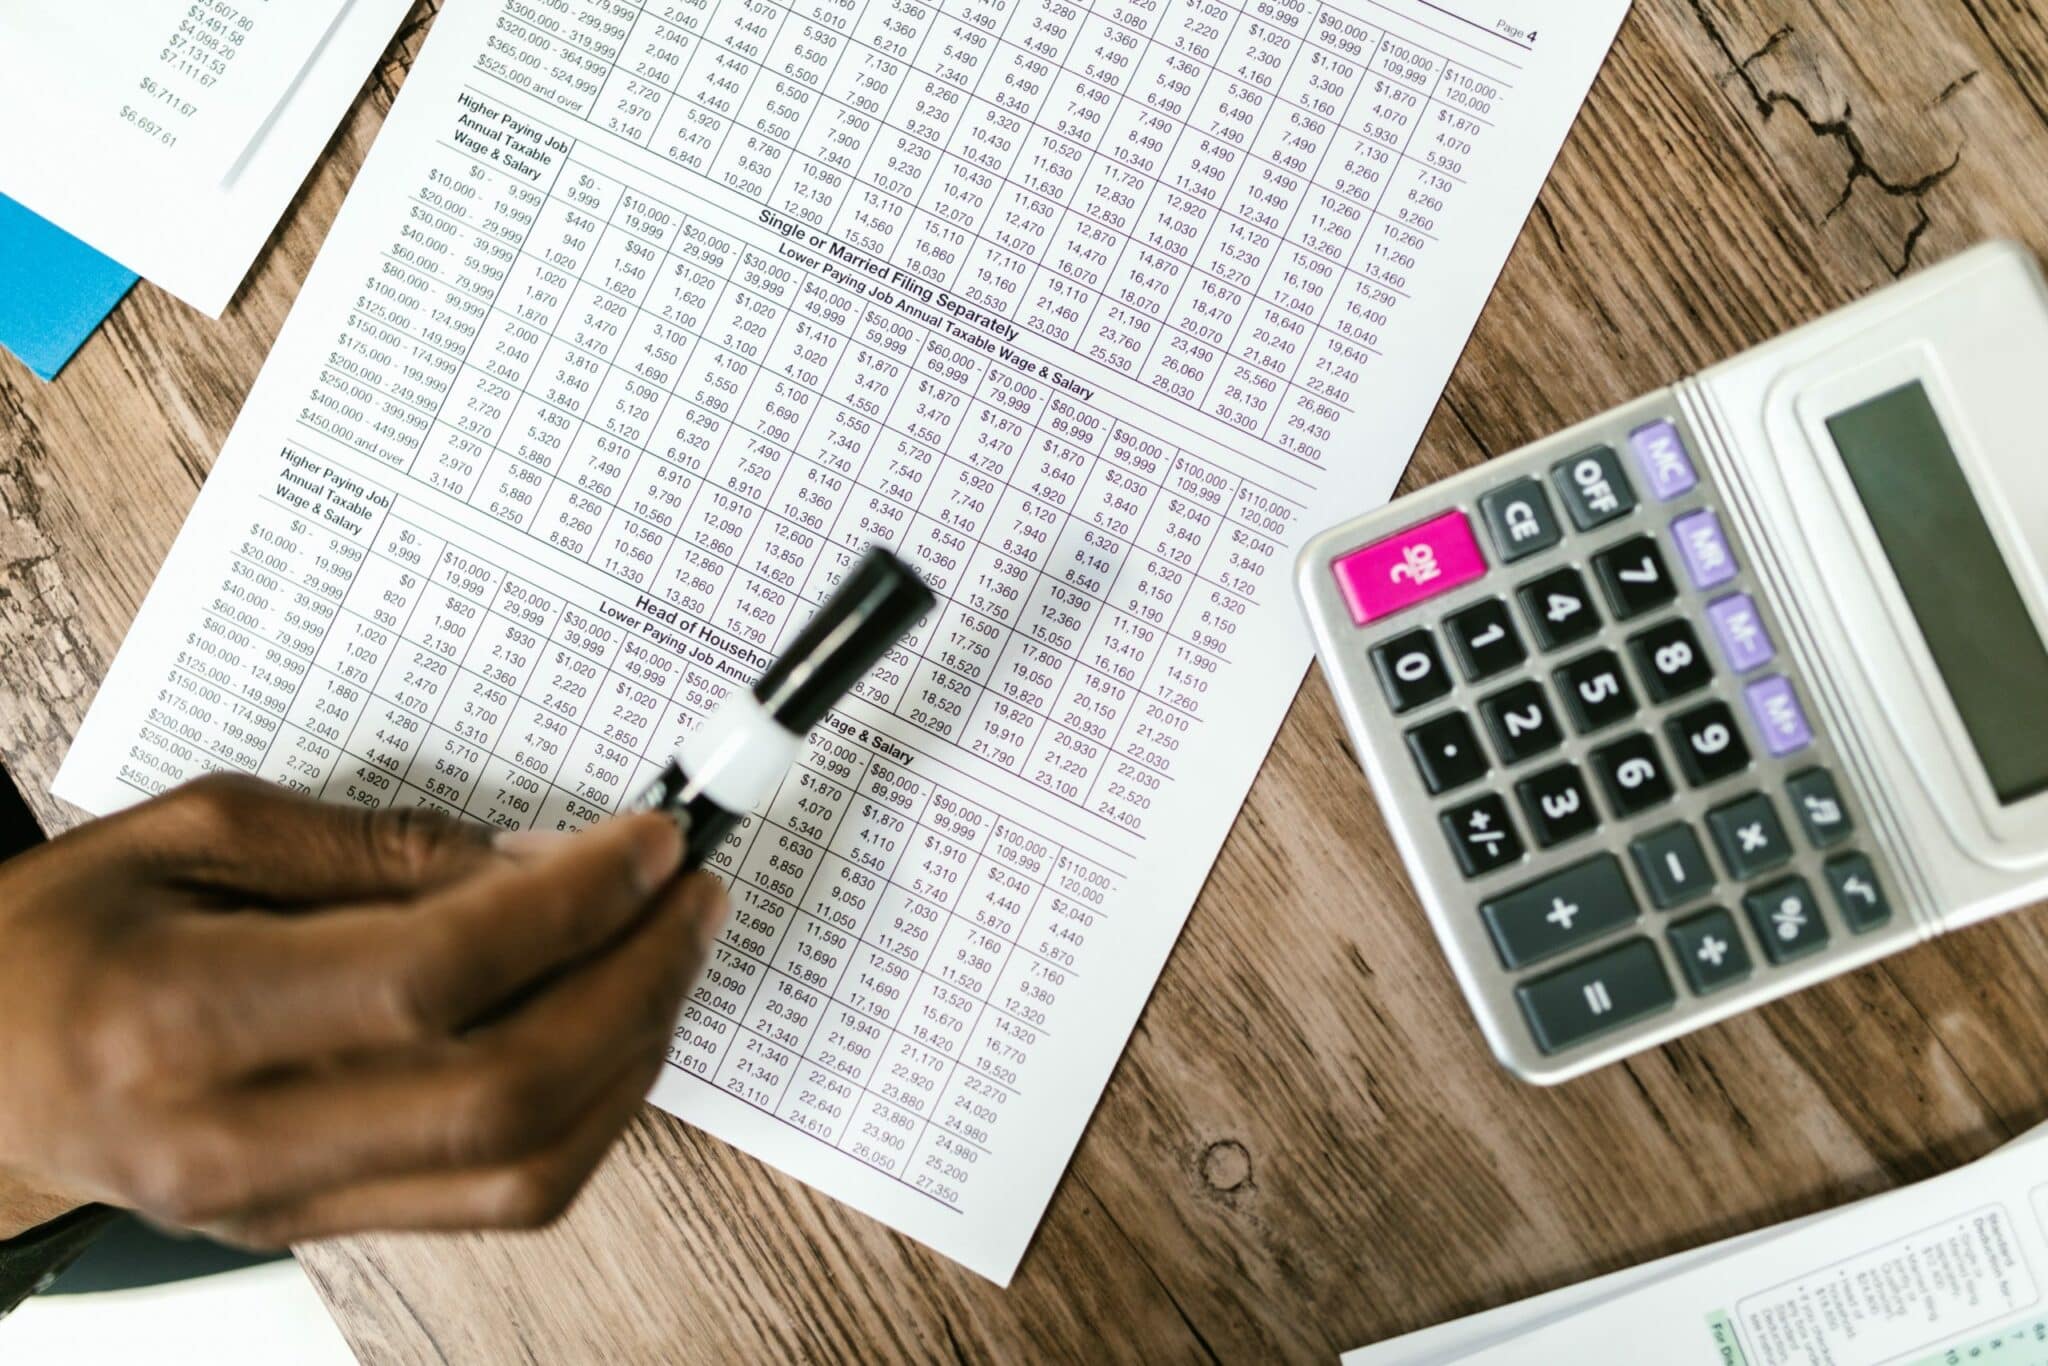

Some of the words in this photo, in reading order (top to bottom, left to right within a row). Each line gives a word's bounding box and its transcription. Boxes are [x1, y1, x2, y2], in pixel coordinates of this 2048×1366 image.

[882, 17, 917, 40] 4,360
[961, 7, 997, 30] 3,490
[1257, 4, 1300, 28] 89,999
[1319, 30, 1362, 57] 99,999
[1495, 18, 1525, 39] Page
[1526, 29, 1539, 44] 4
[1094, 46, 1129, 69] 4,490
[1174, 35, 1211, 60] 3,160
[1245, 45, 1282, 69] 2,300
[935, 62, 969, 86] 7,340
[1311, 51, 1354, 79] $1,100
[476, 53, 533, 88] $525,000
[531, 83, 557, 100] and
[556, 95, 584, 112] over
[626, 80, 662, 104] 2,720
[1446, 87, 1491, 115] 120,000
[456, 91, 501, 121] Higher
[500, 113, 544, 145] Paying
[543, 135, 569, 155] Job
[608, 116, 642, 141] 3,140
[1437, 108, 1481, 136] $1,870
[457, 113, 504, 142] Annual
[504, 133, 552, 166] Taxable
[1127, 129, 1164, 153] 8,490
[1281, 130, 1317, 154] 7,490
[453, 128, 489, 156] Wage
[489, 147, 501, 161] &
[502, 153, 543, 182] Salary
[1033, 154, 1073, 181] 11,630
[1426, 151, 1462, 174] 5,930
[802, 162, 842, 189] 10,980
[1176, 175, 1217, 201] 11,340
[567, 186, 601, 210] 9,999
[1407, 188, 1444, 212] 8,260
[564, 211, 596, 233] $440
[625, 214, 664, 240] 19,999
[472, 236, 514, 263] 39,999
[986, 248, 1027, 275] 17,110
[614, 257, 646, 281] 1,540
[758, 208, 806, 241] Single
[808, 235, 828, 249] or
[827, 241, 891, 280] Married
[890, 271, 934, 303] Filing
[935, 292, 1020, 343] Separately
[906, 257, 946, 284] 18,030
[526, 285, 558, 308] 1,870
[735, 292, 777, 320] $1,020
[1355, 280, 1397, 308] 15,290
[662, 304, 697, 328] 2,100
[777, 235, 822, 270] Lower
[821, 262, 867, 295] Paying
[867, 286, 894, 305] Job
[894, 298, 944, 329] Annual
[945, 319, 996, 354] Taxable
[998, 345, 1037, 373] Wage
[1037, 365, 1050, 380] &
[1051, 371, 1095, 402] Salary
[504, 321, 540, 345] 2,000
[1252, 327, 1296, 355] 20,240
[1170, 336, 1214, 364] 23,490
[390, 383, 439, 413] 249,999
[918, 379, 961, 408] $1,870
[989, 387, 1032, 415] 79,999
[764, 400, 800, 425] 6,690
[299, 407, 355, 441] $450,000
[353, 436, 379, 454] and
[378, 448, 405, 466] over
[1278, 433, 1322, 461] 31,800
[1648, 438, 1688, 483] MC
[279, 445, 323, 475] Higher
[322, 467, 365, 499] Paying
[365, 490, 390, 509] Job
[807, 467, 843, 492] 8,140
[1177, 476, 1222, 505] 109,999
[1573, 458, 1619, 513] OFF
[279, 467, 325, 496] Annual
[326, 487, 373, 521] Taxable
[275, 483, 311, 510] Wage
[311, 502, 322, 516] &
[323, 508, 363, 537] Salary
[489, 501, 524, 525] 6,250
[1504, 501, 1540, 542] CE
[1689, 526, 1725, 573] MR
[1229, 552, 1265, 577] 3,840
[1619, 556, 1658, 584] 7
[444, 596, 476, 620] $820
[969, 593, 1010, 621] 13,750
[1547, 593, 1582, 622] 4
[563, 629, 605, 657] 39,999
[598, 600, 642, 630] Lower
[641, 621, 688, 655] Paying
[688, 646, 715, 666] Job
[714, 659, 759, 692] Annua
[634, 594, 679, 625] Head
[679, 619, 699, 635] of
[697, 625, 773, 671] Househol
[1471, 623, 1505, 649] 1
[1177, 646, 1218, 674] 11,990
[1395, 651, 1432, 682] 0
[1655, 641, 1693, 674] 8
[336, 660, 369, 684] 1,870
[551, 674, 588, 699] 2,220
[1003, 681, 1044, 709] 19,820
[1579, 673, 1620, 704] 5
[231, 702, 277, 733] 174,999
[1145, 704, 1190, 732] 20,010
[1503, 705, 1543, 738] 2
[857, 729, 870, 744] &
[872, 735, 915, 766] Salary
[1691, 723, 1730, 755] 9
[128, 745, 184, 779] $350,000
[435, 758, 470, 783] 5,870
[1616, 757, 1656, 789] 6
[356, 767, 390, 791] 4,920
[1097, 800, 1142, 830] 24,400
[1542, 787, 1580, 820] 3
[778, 835, 814, 860] 6,630
[1050, 898, 1094, 928] $2,040
[778, 980, 818, 1009] 18,640
[986, 1036, 1027, 1065] 16,770
[954, 1095, 998, 1125] 24,020
[852, 1142, 896, 1171] 26,050
[915, 1173, 959, 1203] 27,350
